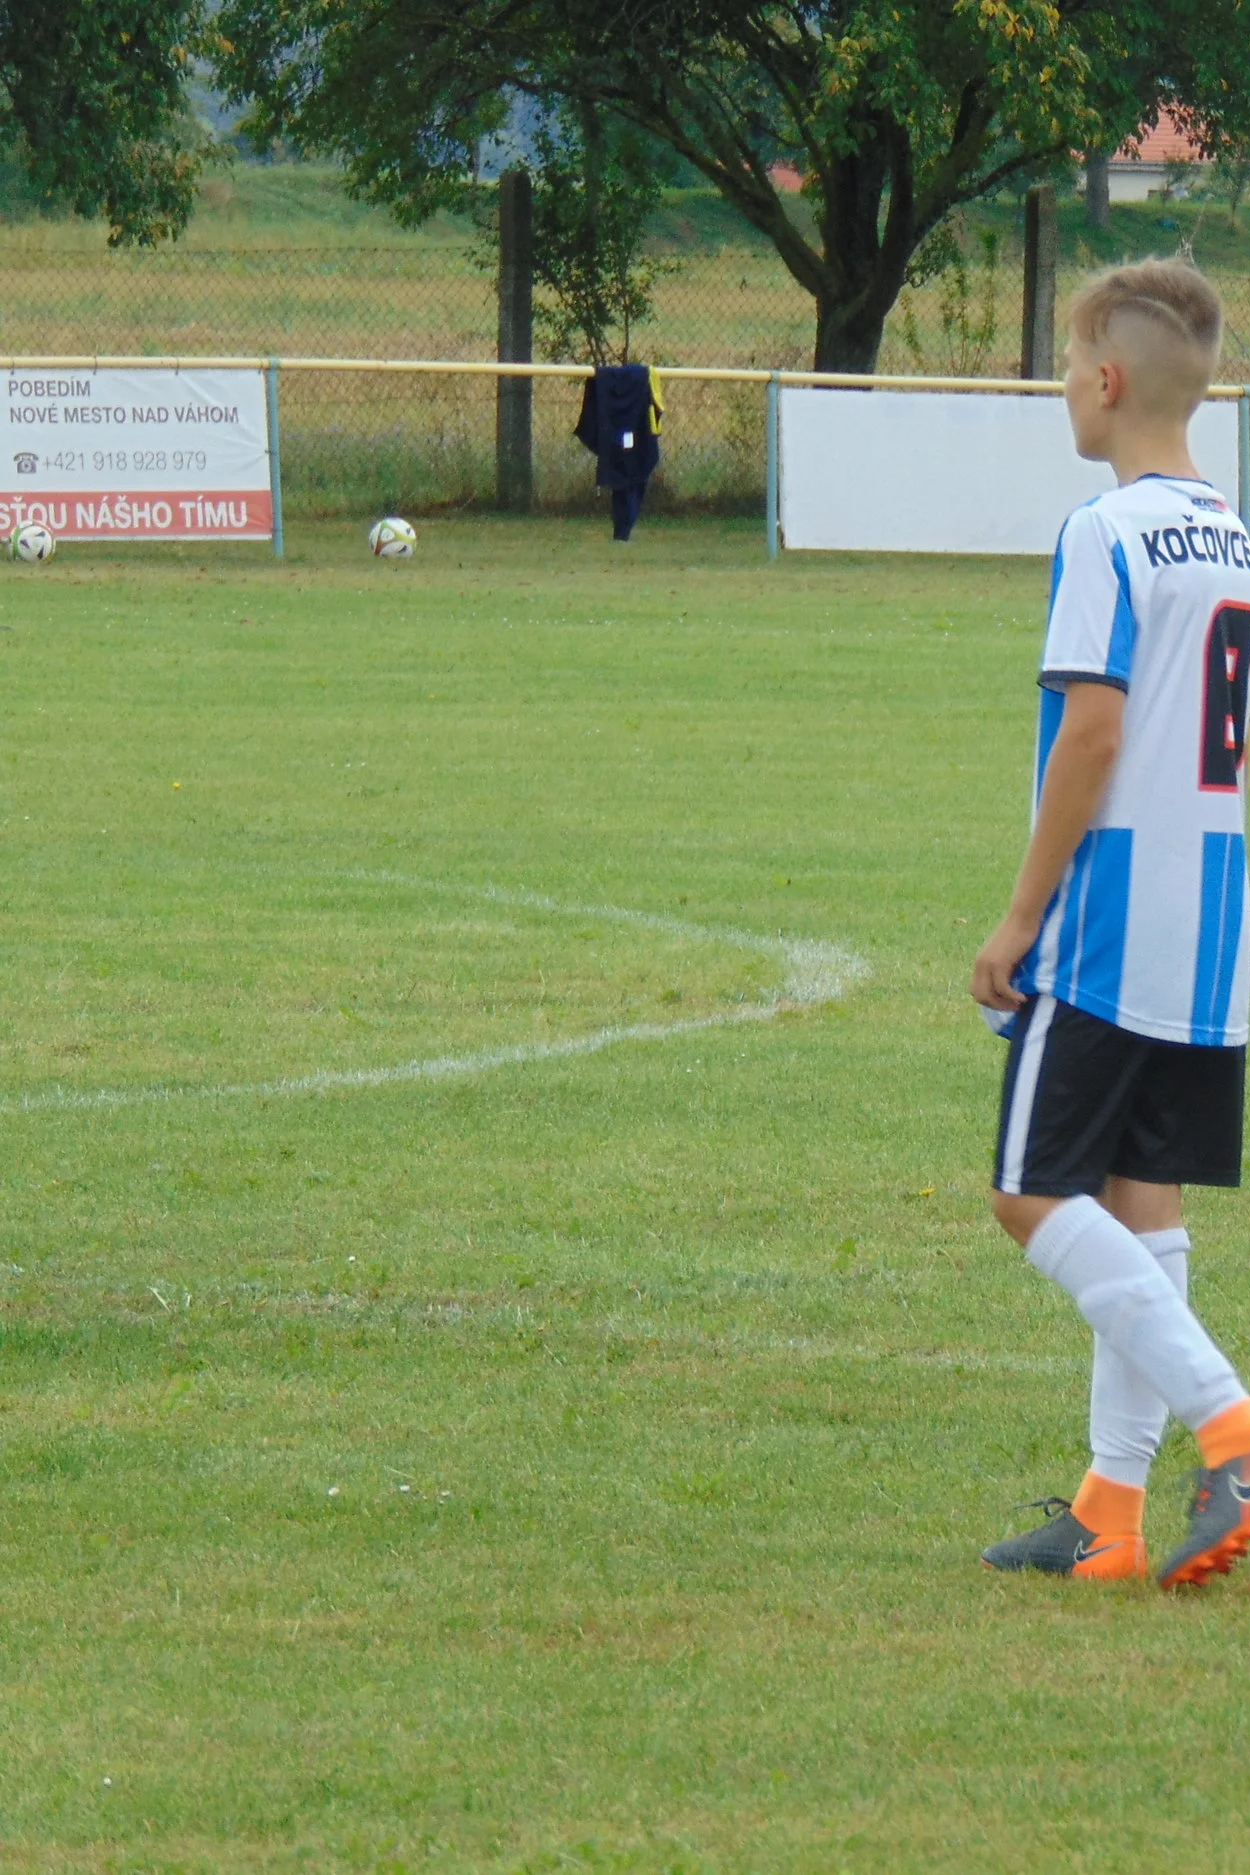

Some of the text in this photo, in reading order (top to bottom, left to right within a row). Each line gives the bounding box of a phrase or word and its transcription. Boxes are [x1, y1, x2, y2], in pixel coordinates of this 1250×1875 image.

[8, 376, 91, 397] POBEDÍM
[9, 402, 239, 424] NOVÉ MESTO NAD VÁHOM
[43, 451, 207, 471] +421 918 928 979
[76, 495, 173, 529] NÁŠHO
[179, 495, 248, 528] TÍMU
